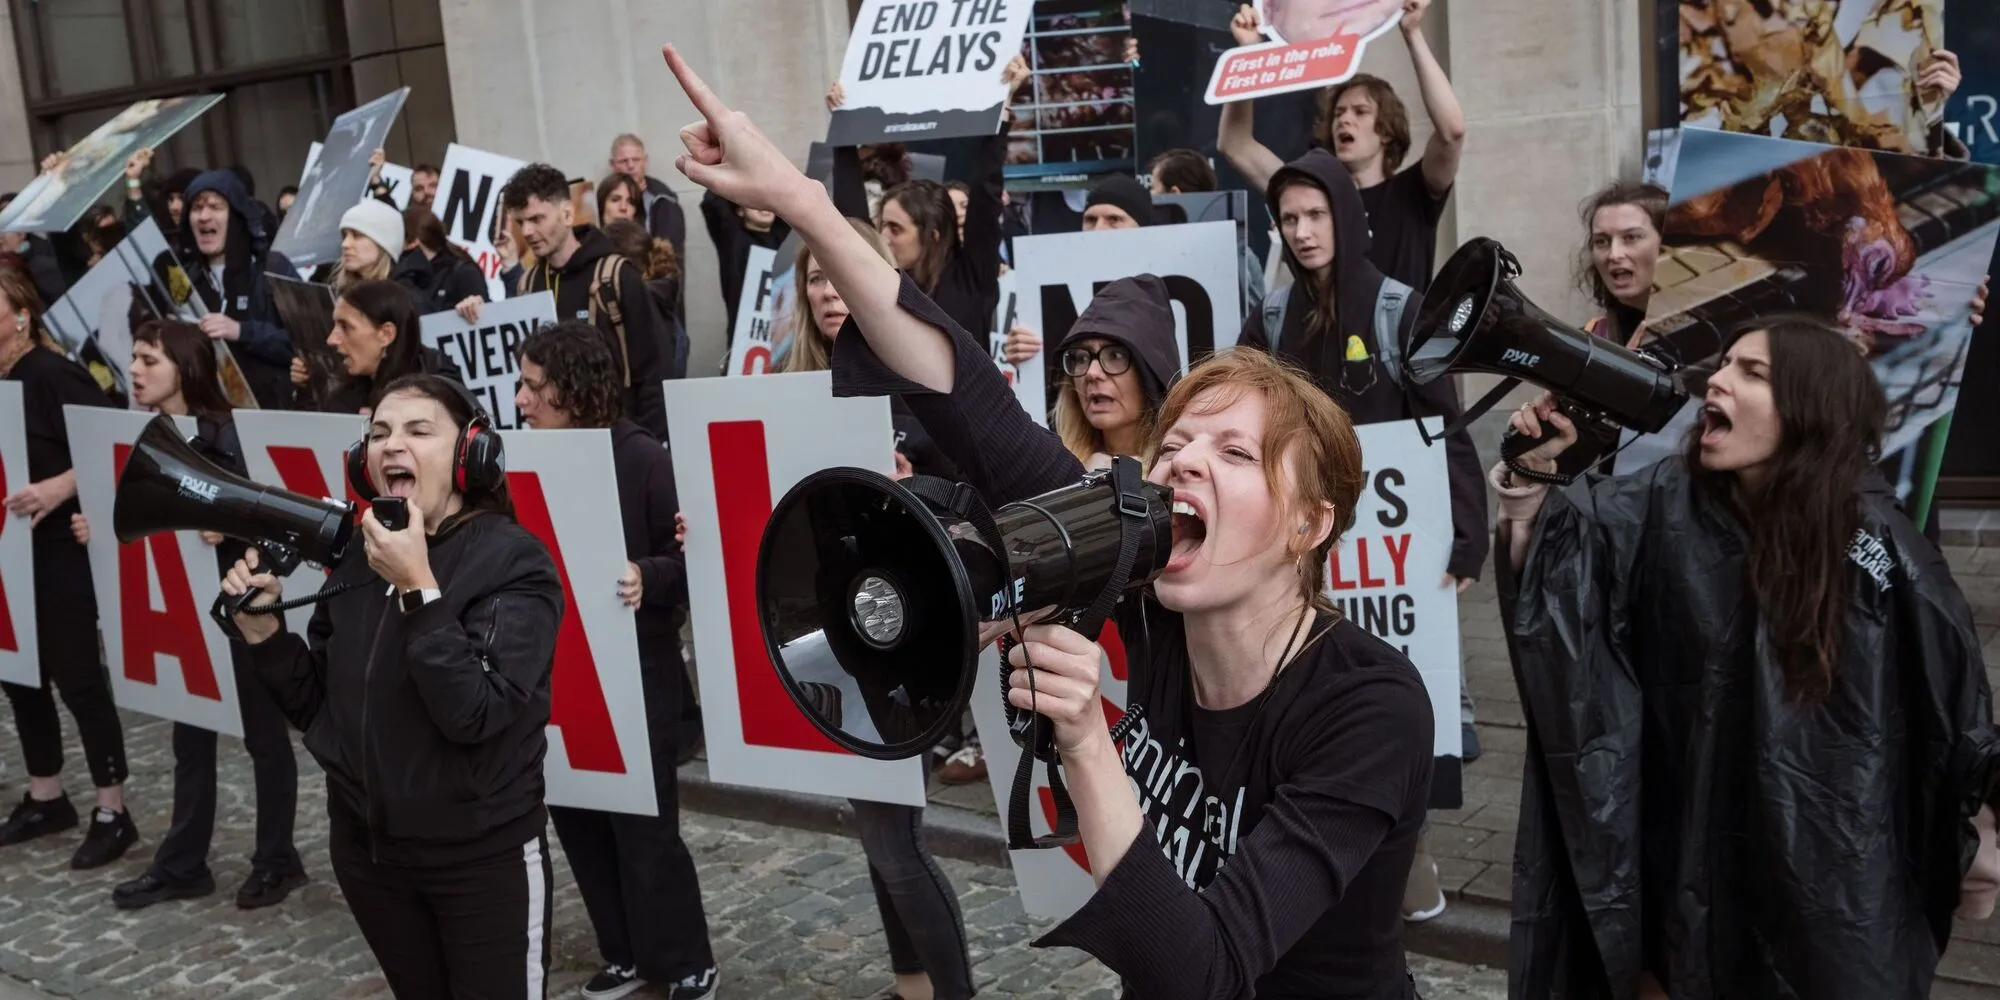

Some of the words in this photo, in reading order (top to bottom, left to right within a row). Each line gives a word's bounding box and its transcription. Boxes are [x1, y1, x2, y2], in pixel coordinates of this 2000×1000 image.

[871, 1, 939, 35] END
[946, 0, 1008, 28] THE
[858, 31, 1002, 81] DELAYS
[1229, 56, 1264, 74] First
[1265, 53, 1282, 67] in
[1283, 47, 1309, 64] the
[1311, 42, 1345, 60] role.
[1223, 74, 1257, 90] First
[1260, 70, 1277, 84] to
[1278, 64, 1305, 81] fail
[443, 168, 503, 244] N
[1501, 348, 1540, 367] PYLE
[180, 475, 220, 500] PYLE
[1330, 534, 1411, 591] LLY
